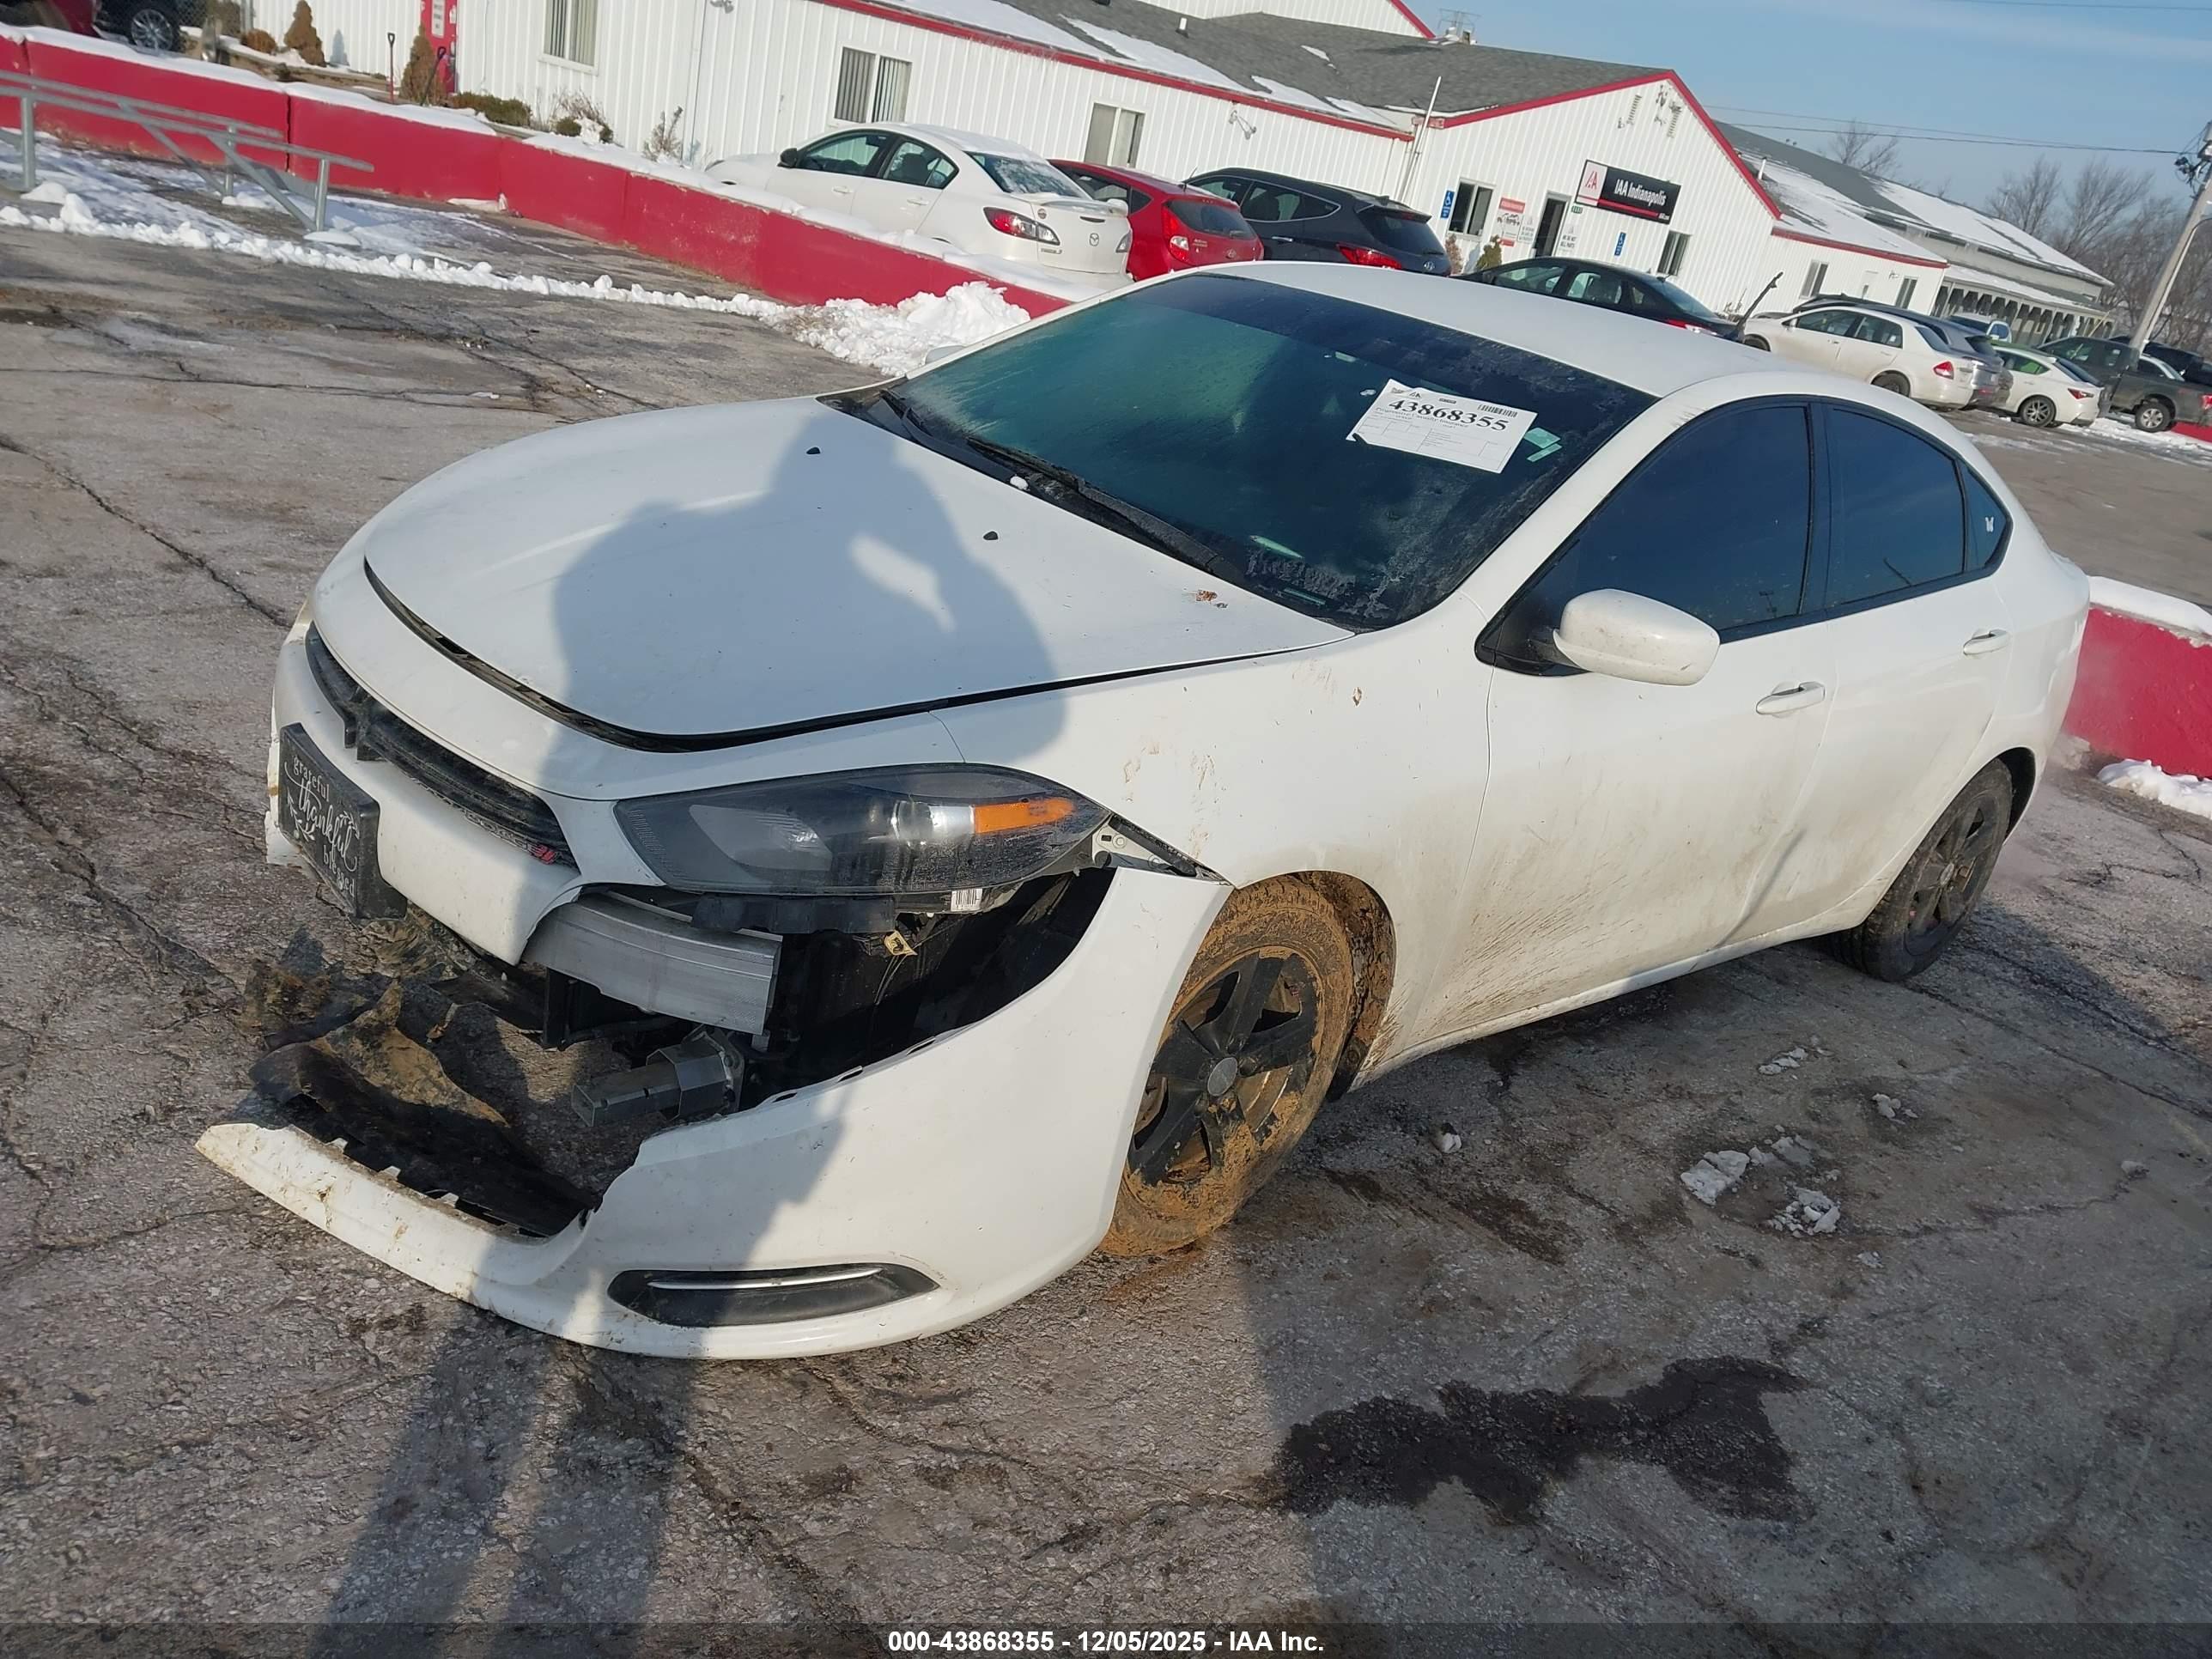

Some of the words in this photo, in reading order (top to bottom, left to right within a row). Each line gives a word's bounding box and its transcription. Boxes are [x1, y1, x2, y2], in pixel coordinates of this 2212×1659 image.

[1614, 179, 1629, 198] IAA
[1627, 182, 1667, 207] Indianapolis
[1389, 399, 1510, 431] 43868355
[294, 756, 330, 803] grateful
[284, 761, 358, 872] thankful
[323, 844, 356, 898] blessed
